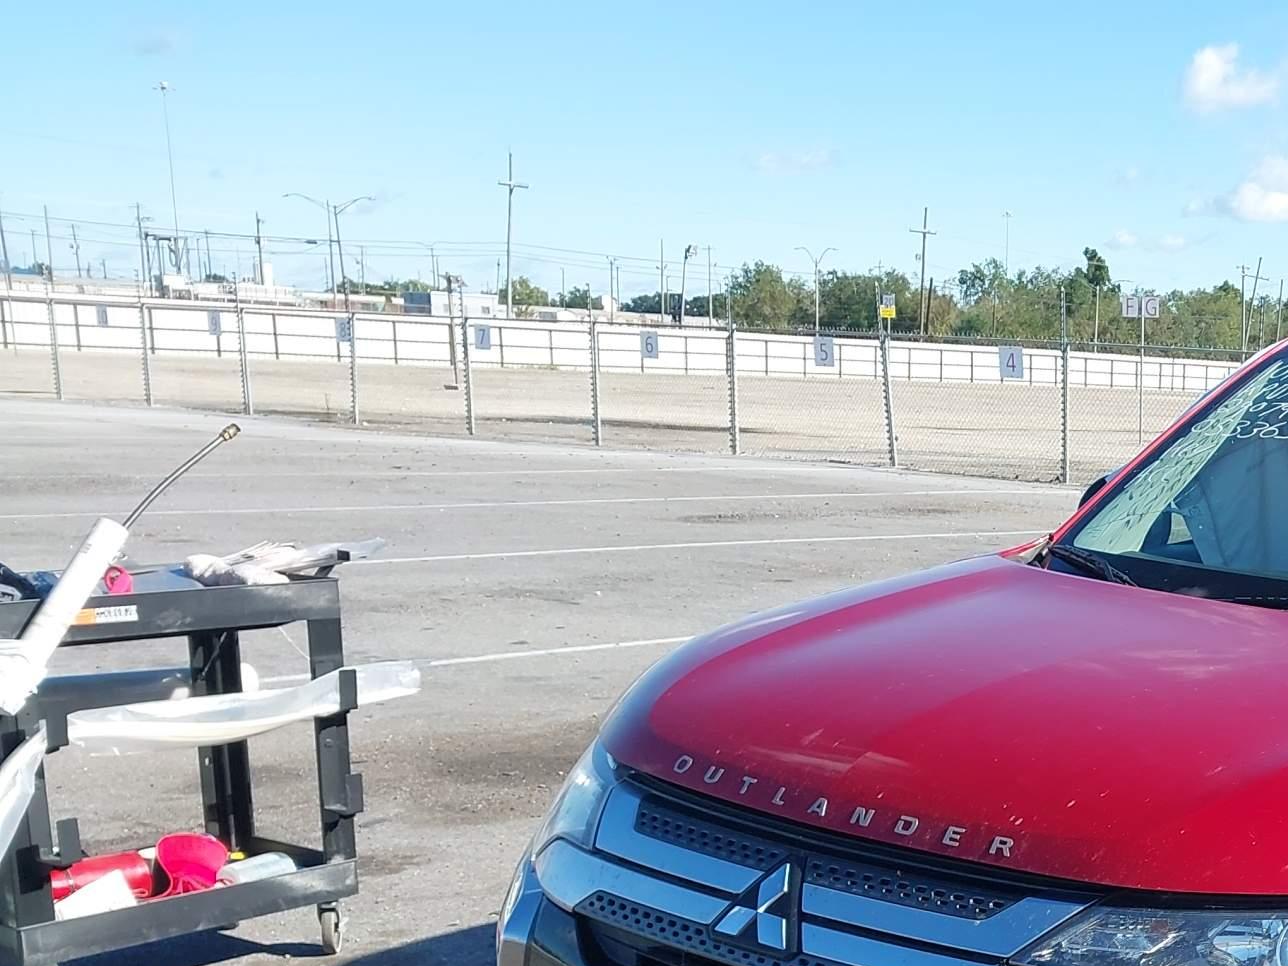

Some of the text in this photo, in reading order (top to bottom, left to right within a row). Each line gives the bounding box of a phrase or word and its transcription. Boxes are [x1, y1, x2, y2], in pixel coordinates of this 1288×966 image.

[1126, 297, 1134, 316] F
[1145, 298, 1157, 316] G
[478, 329, 486, 345] 7
[645, 336, 654, 354] 6
[819, 343, 828, 361] 5
[1006, 353, 1017, 372] 4
[673, 754, 1015, 858] OUTLANDER
